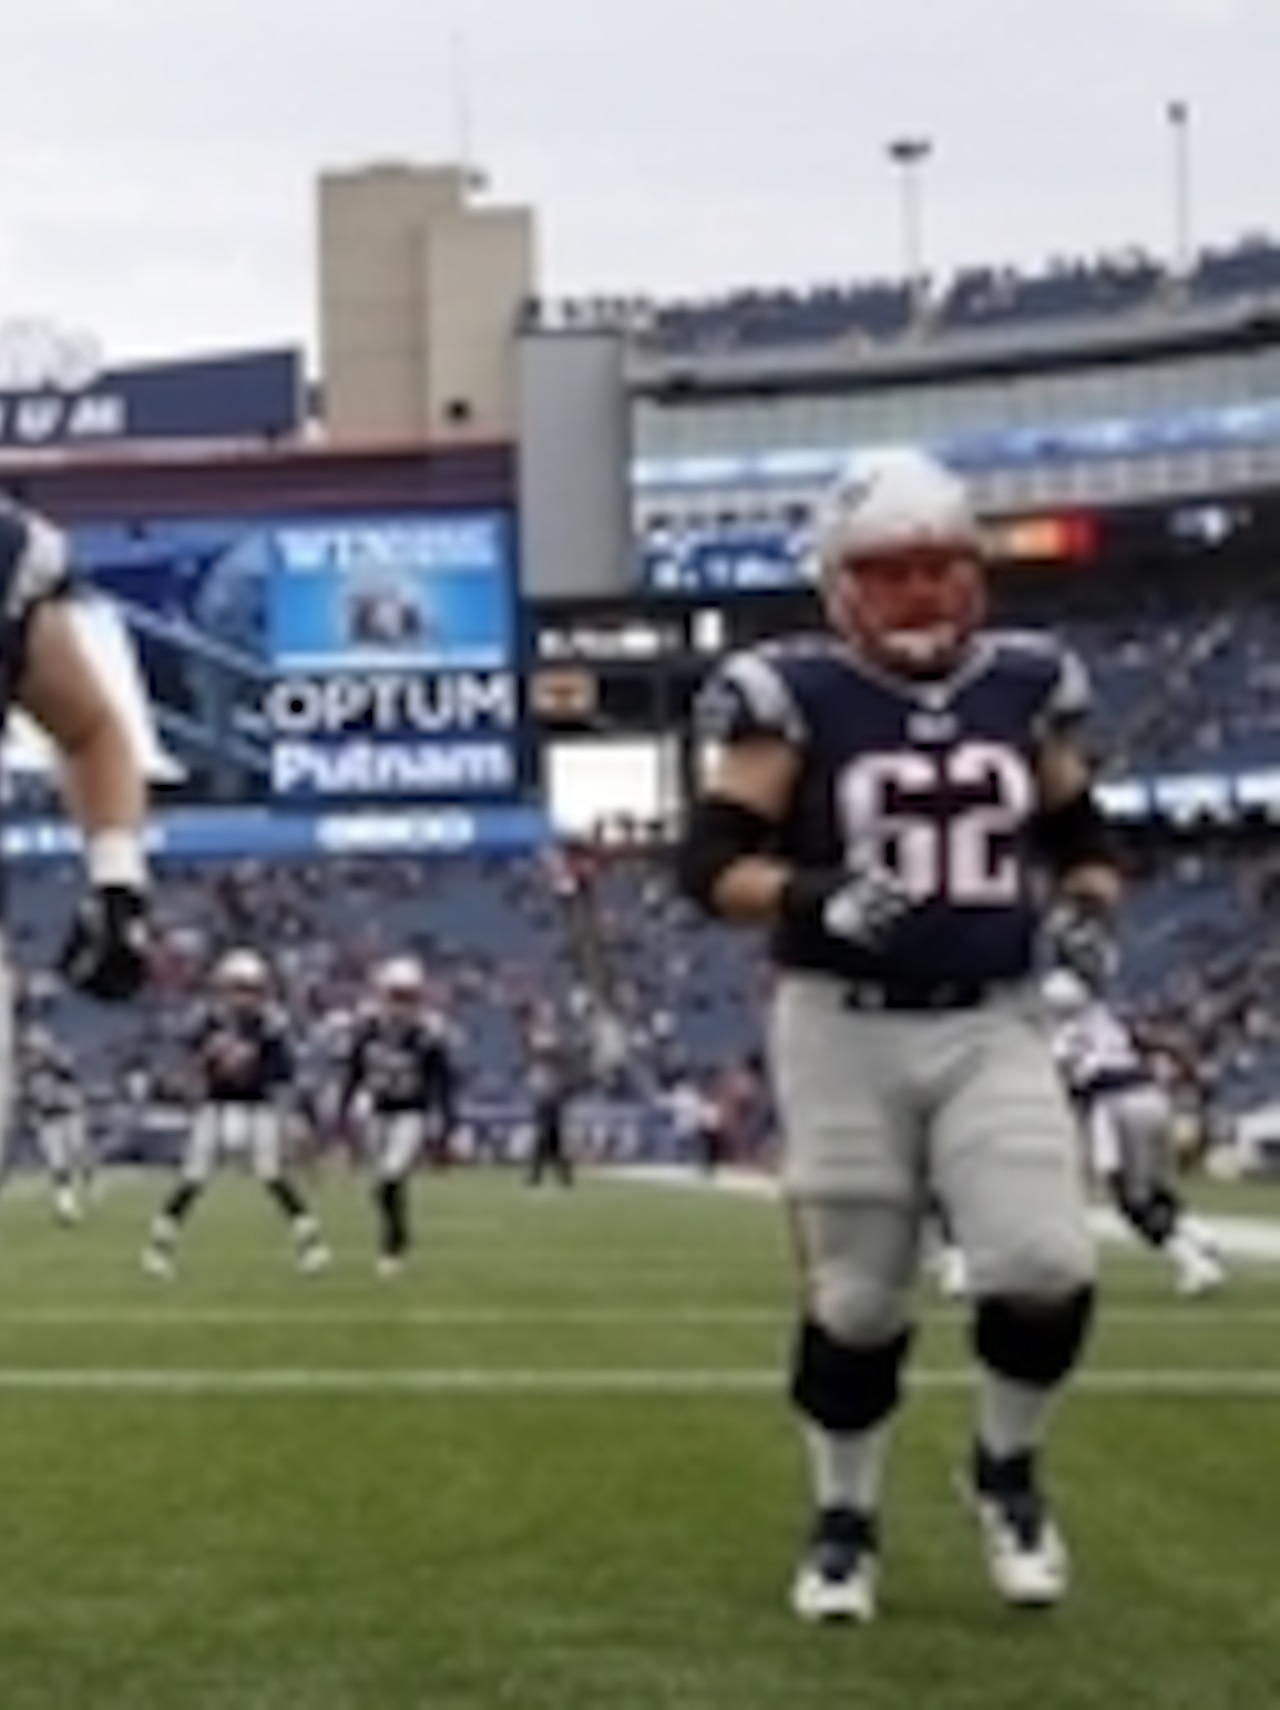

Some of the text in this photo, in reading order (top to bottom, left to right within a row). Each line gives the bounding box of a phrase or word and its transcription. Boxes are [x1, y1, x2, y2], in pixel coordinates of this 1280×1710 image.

[267, 674, 515, 733] OPTUM
[272, 740, 512, 795] Putnam
[838, 742, 1035, 905] 62
